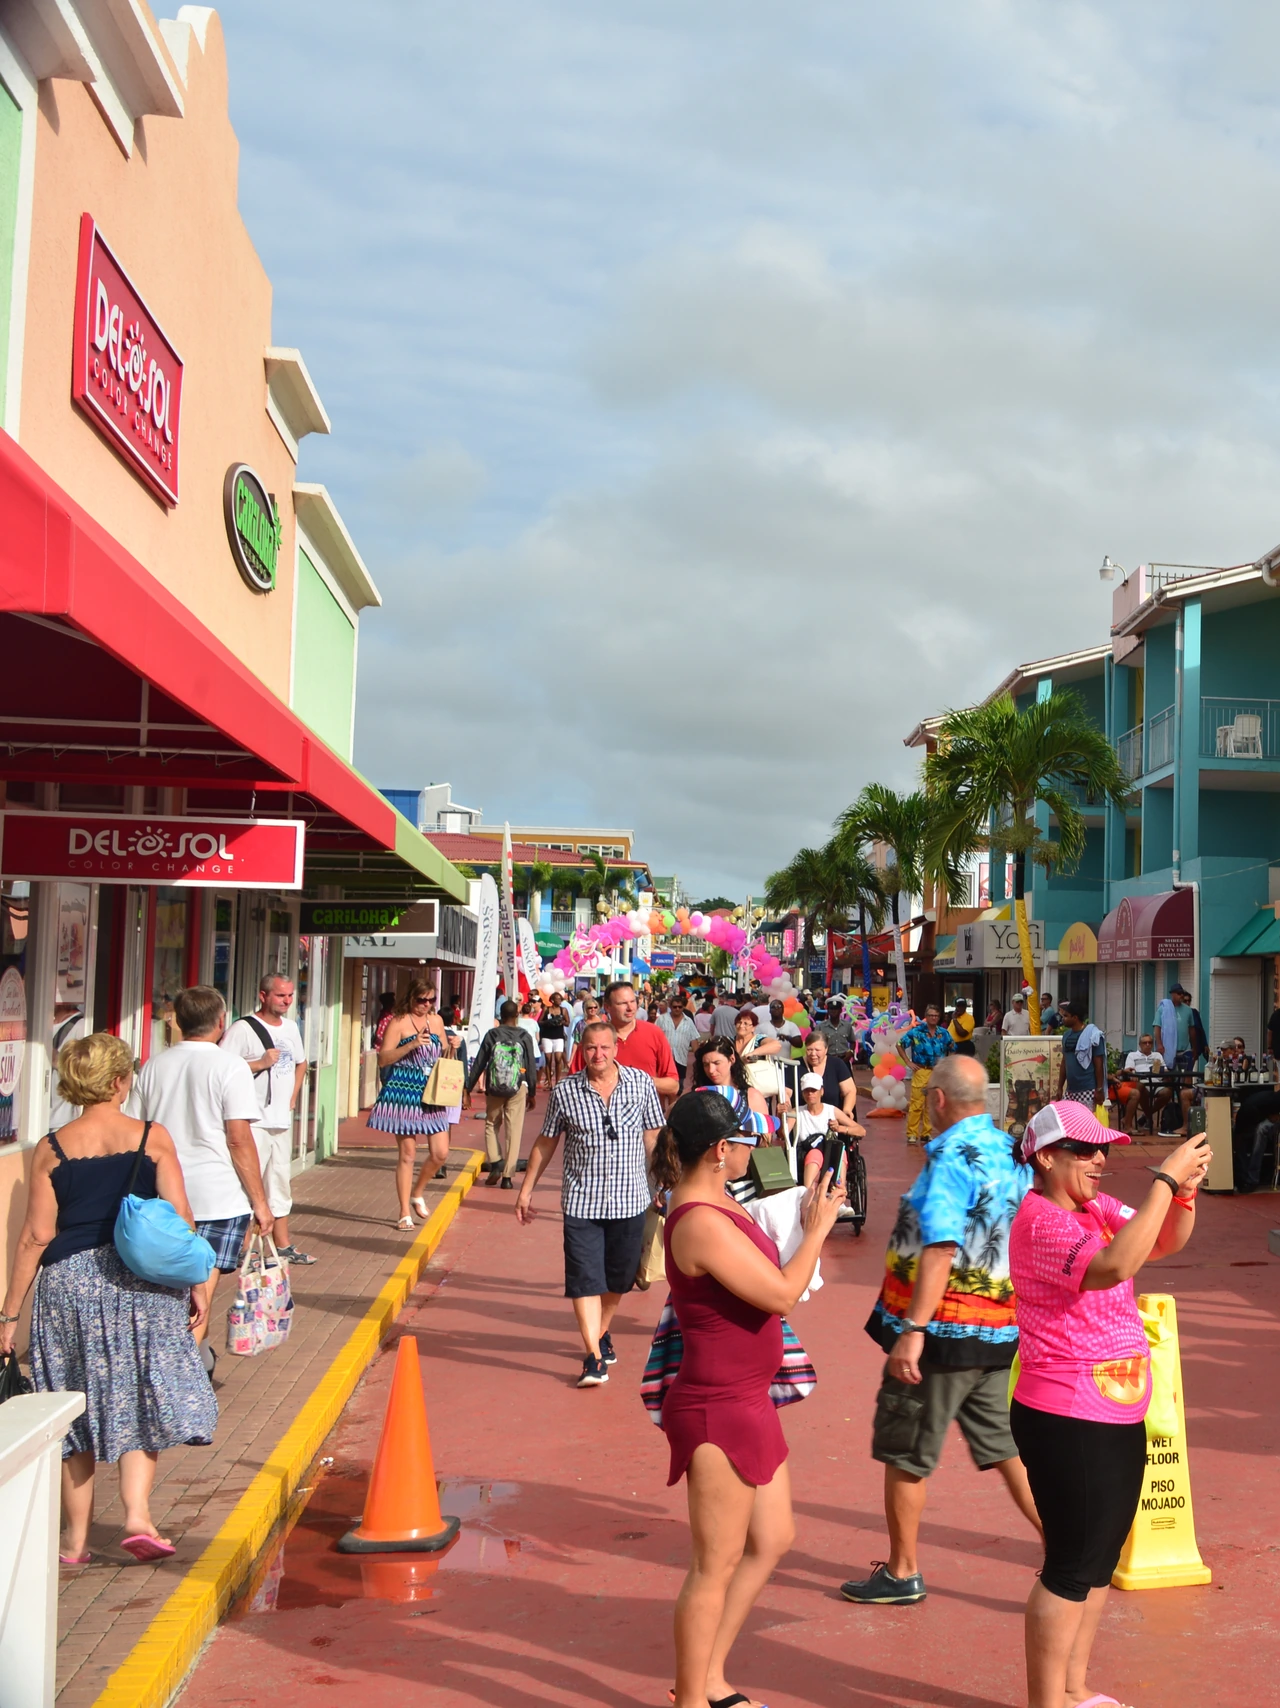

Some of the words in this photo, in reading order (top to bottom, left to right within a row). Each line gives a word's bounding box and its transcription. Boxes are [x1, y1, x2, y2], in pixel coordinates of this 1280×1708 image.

[95, 277, 126, 382] DEL
[144, 358, 172, 443] SOL
[93, 357, 128, 416] COLOR
[134, 412, 172, 471] CHANGE
[69, 828, 127, 857] DEL
[171, 832, 234, 861] SOL
[68, 860, 134, 870] COLOR
[152, 863, 234, 874] CHANGE
[1146, 1452, 1179, 1465] FLOOR
[1151, 1479, 1175, 1493] PISO
[1141, 1496, 1185, 1511] MOJADO
